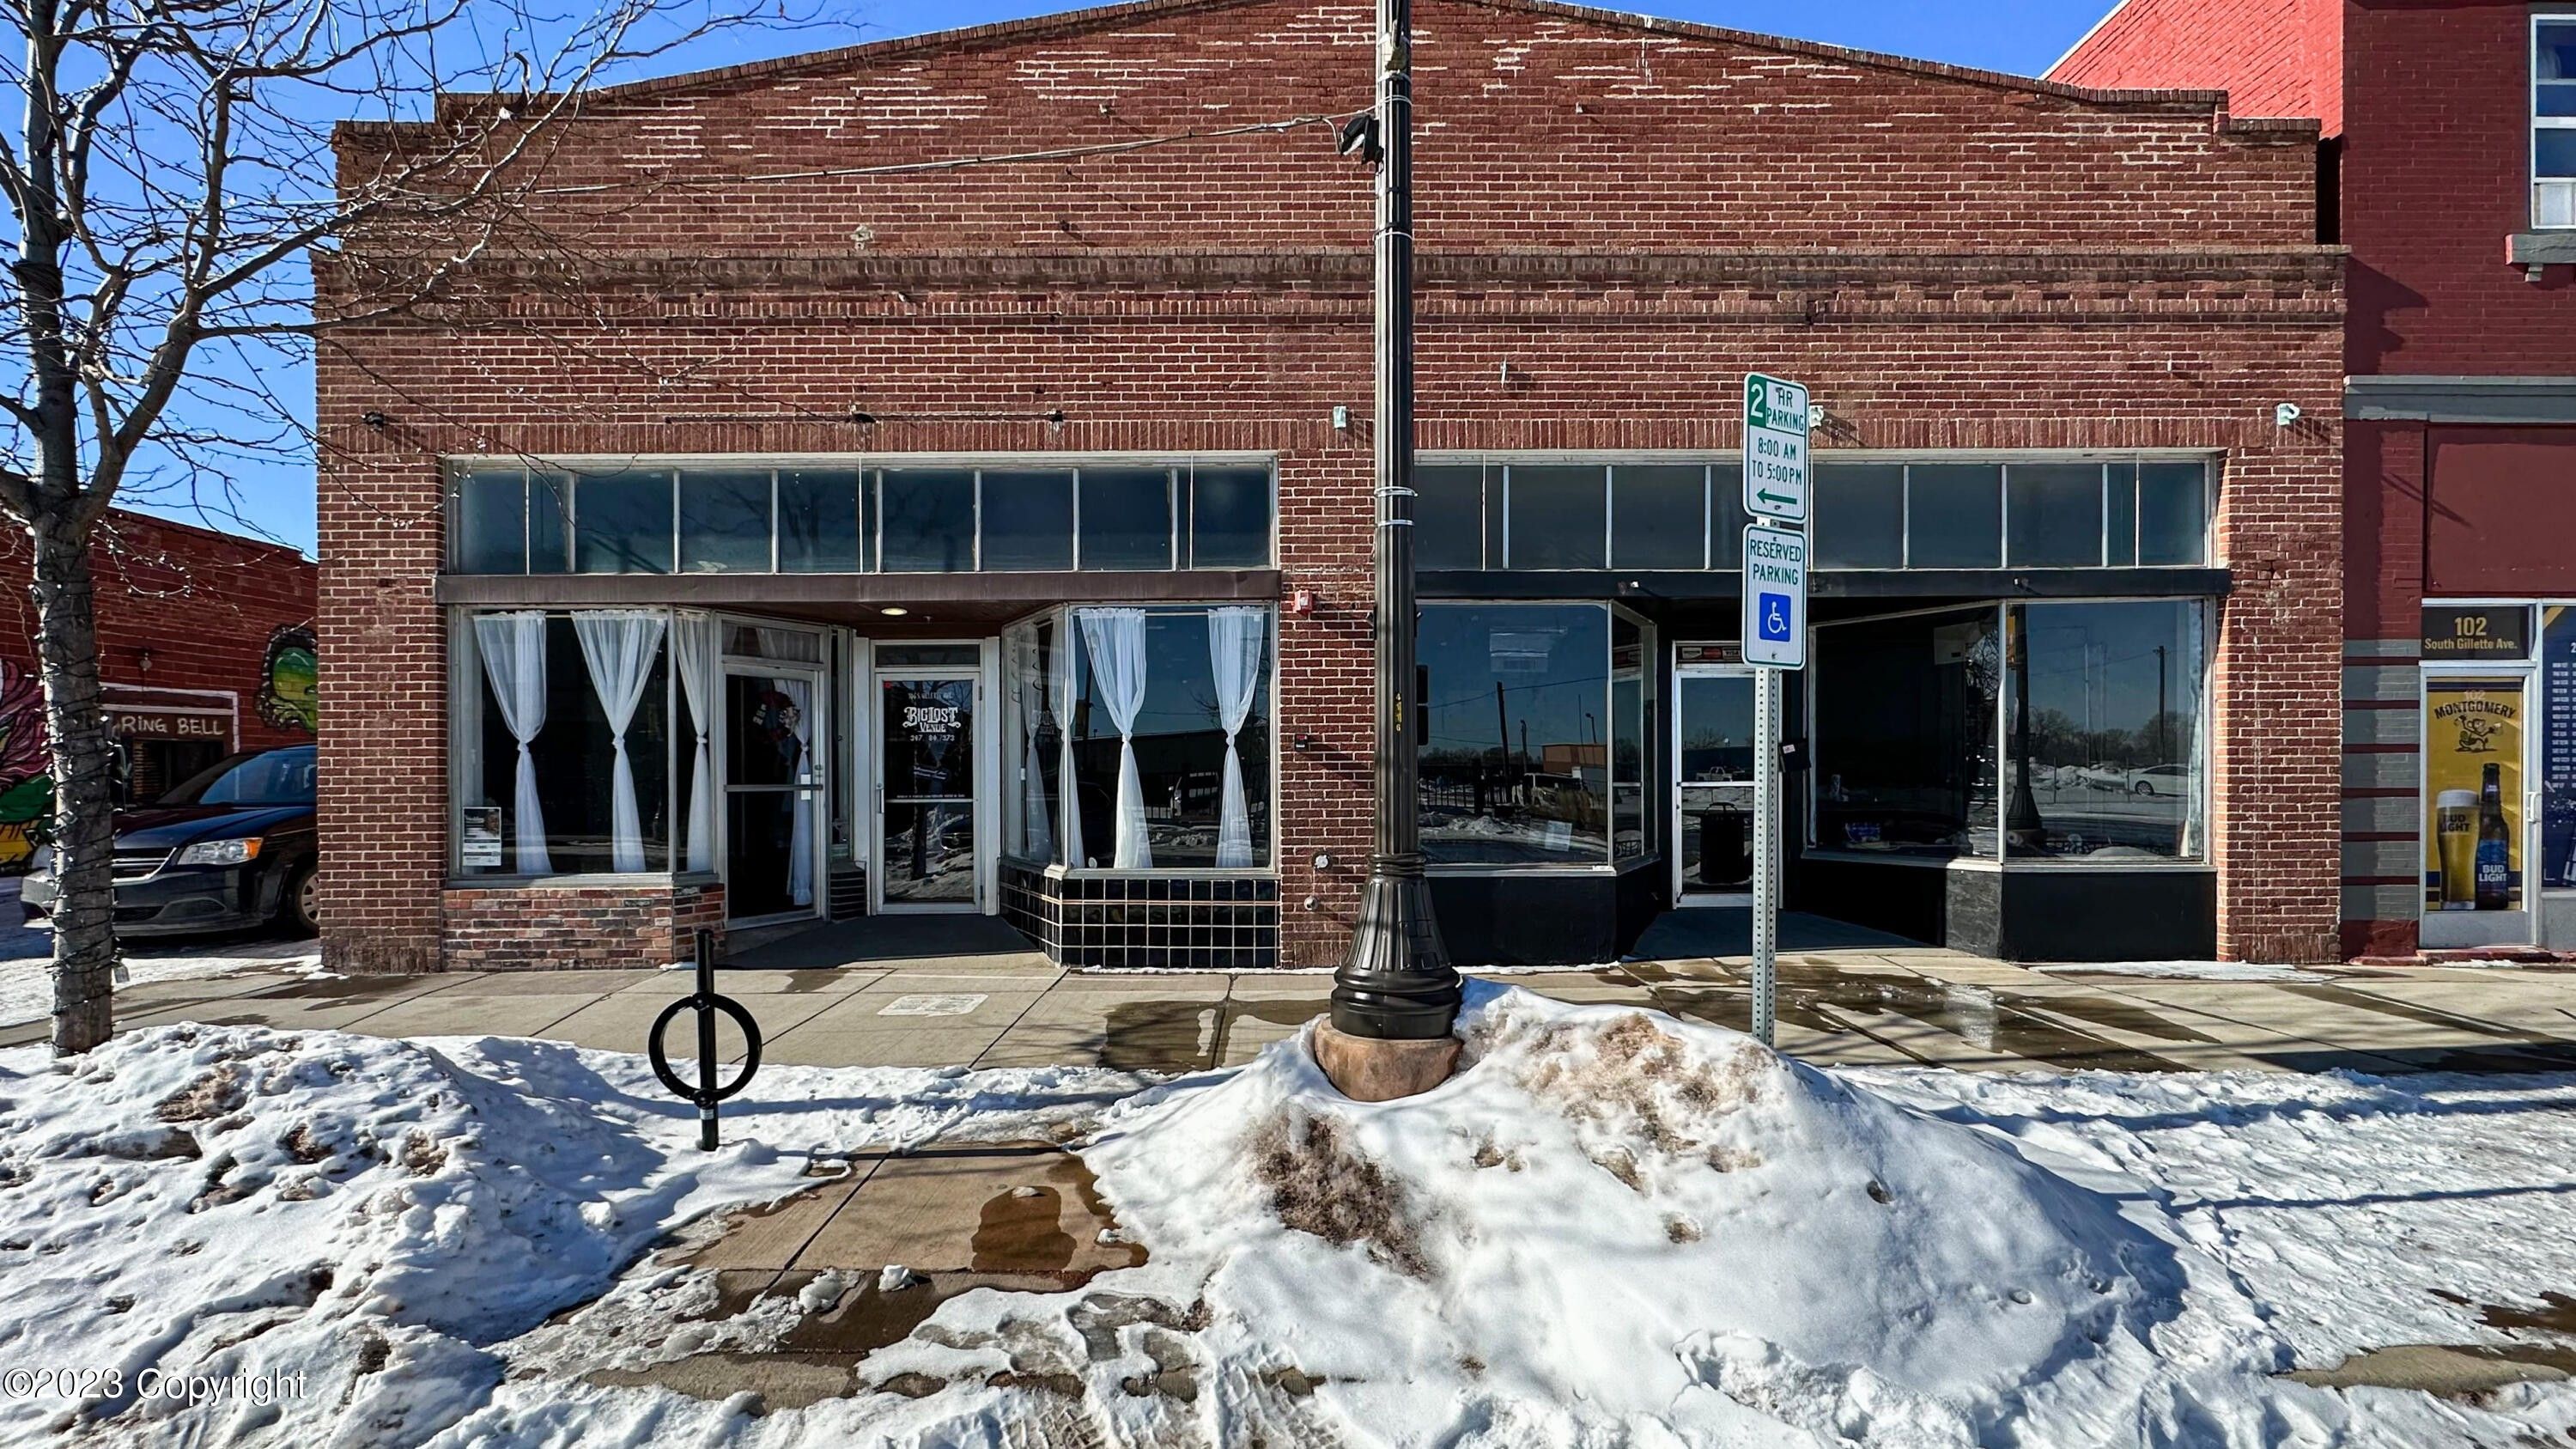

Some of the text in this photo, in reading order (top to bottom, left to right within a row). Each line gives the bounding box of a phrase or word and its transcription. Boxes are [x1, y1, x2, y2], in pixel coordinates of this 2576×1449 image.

[1751, 383, 1764, 418] 2
[1778, 387, 1793, 408] HR
[1766, 407, 1804, 432] PARKING
[1758, 436, 1796, 461] 8:00 AM
[1752, 460, 1764, 478] TO
[1749, 539, 1802, 563] RESERVED
[1753, 563, 1799, 586] PARKING
[2454, 617, 2487, 636] 102
[2424, 637, 2518, 650] South Gillette Ave.
[2434, 700, 2517, 720] MONTGOMERY
[177, 716, 225, 735] BELL
[918, 721, 947, 733] VENUE
[2478, 873, 2507, 882] LIGHT
[2482, 864, 2505, 874] BUD
